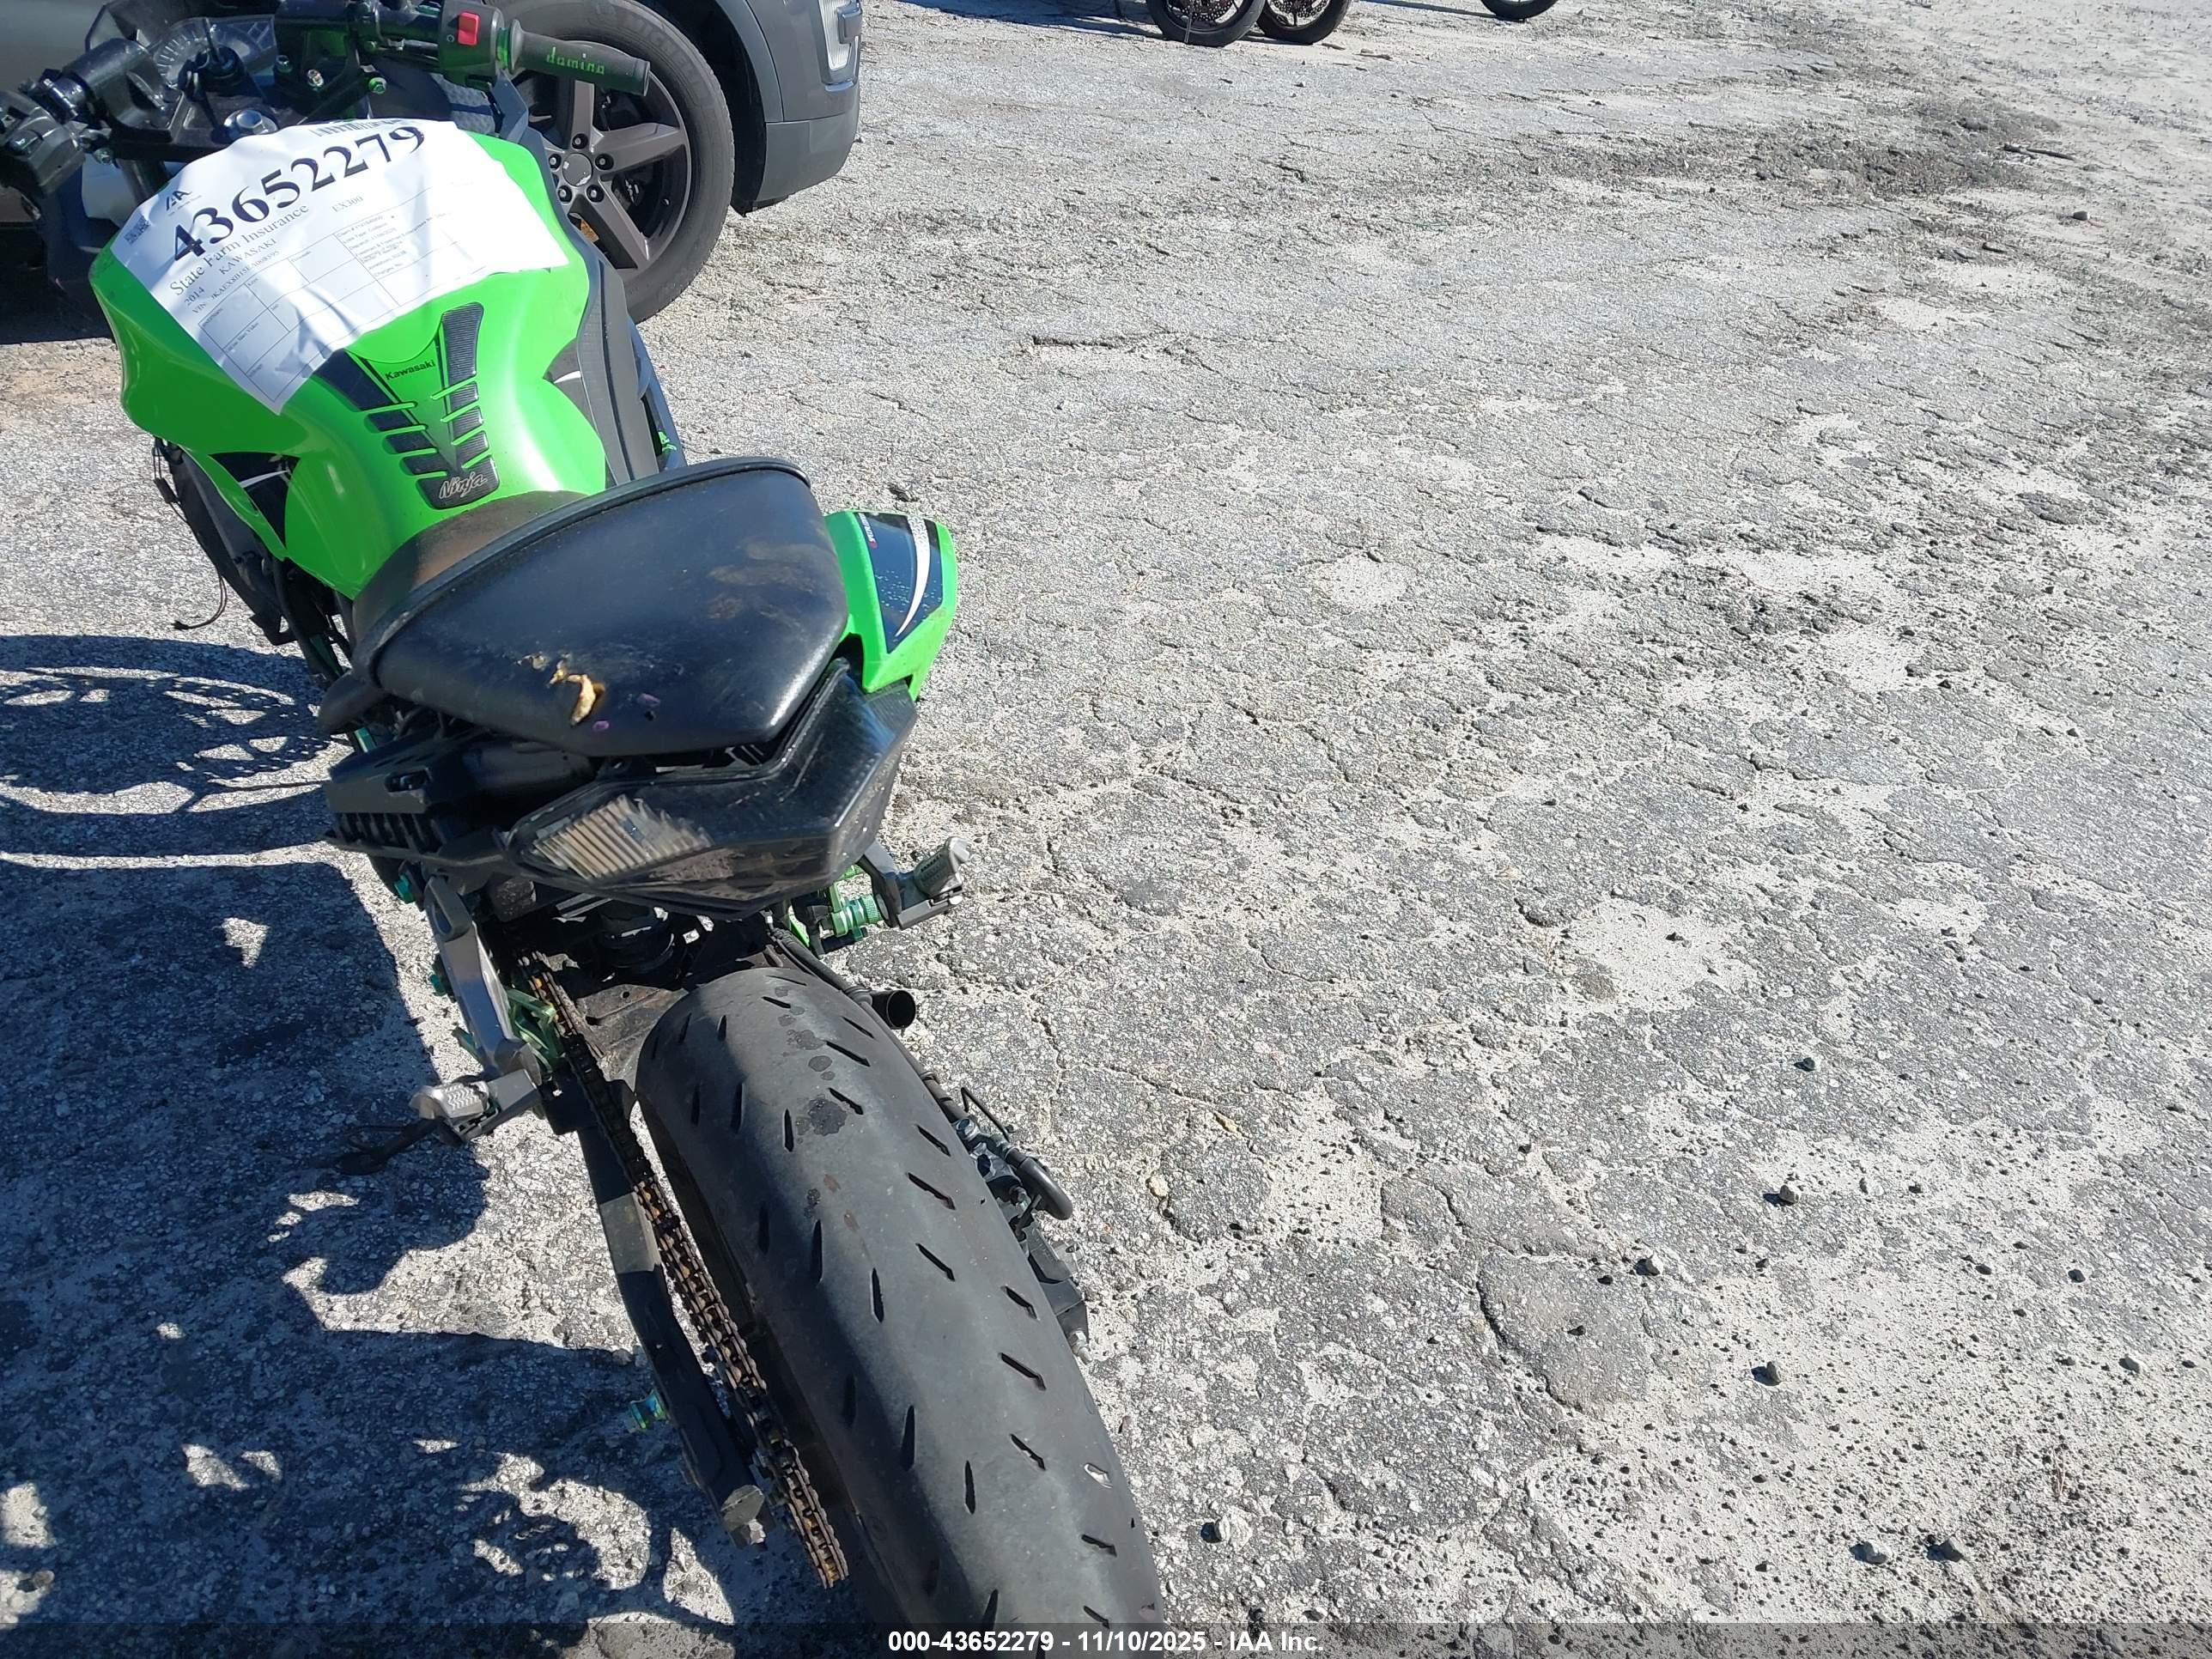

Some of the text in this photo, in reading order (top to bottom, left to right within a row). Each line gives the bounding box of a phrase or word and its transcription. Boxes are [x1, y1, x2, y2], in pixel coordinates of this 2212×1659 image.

[173, 126, 425, 262] 43652279
[170, 266, 205, 295] State
[203, 240, 241, 267] Farm
[241, 204, 310, 248] Insurance
[184, 287, 205, 306] 2014
[219, 238, 277, 276] KAWASAKI
[331, 196, 364, 212] EX300
[385, 360, 436, 380] Kawasaki
[439, 471, 488, 501] Ninja
